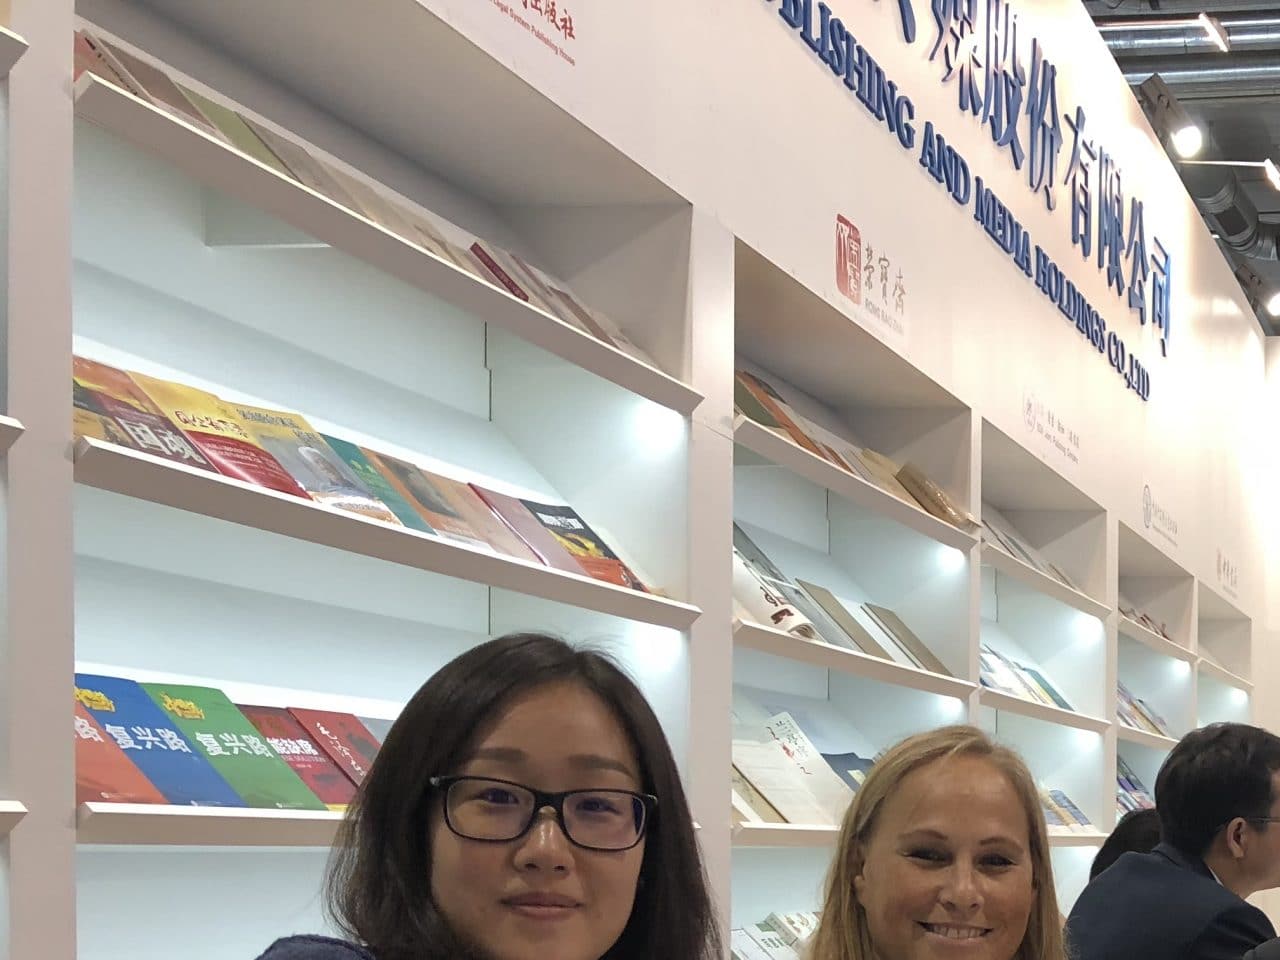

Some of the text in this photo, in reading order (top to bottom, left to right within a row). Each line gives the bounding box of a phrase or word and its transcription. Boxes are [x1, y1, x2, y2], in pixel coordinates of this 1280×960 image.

[531, 25, 558, 55] Publishing
[897, 0, 1172, 358] 媒股份有限公司
[919, 121, 971, 206] AND
[974, 175, 1033, 278] MEDIA
[1034, 244, 1107, 354] HOLDINGS
[75, 715, 104, 743] 路
[105, 723, 192, 754] 复兴路
[195, 731, 274, 759] 复兴路
